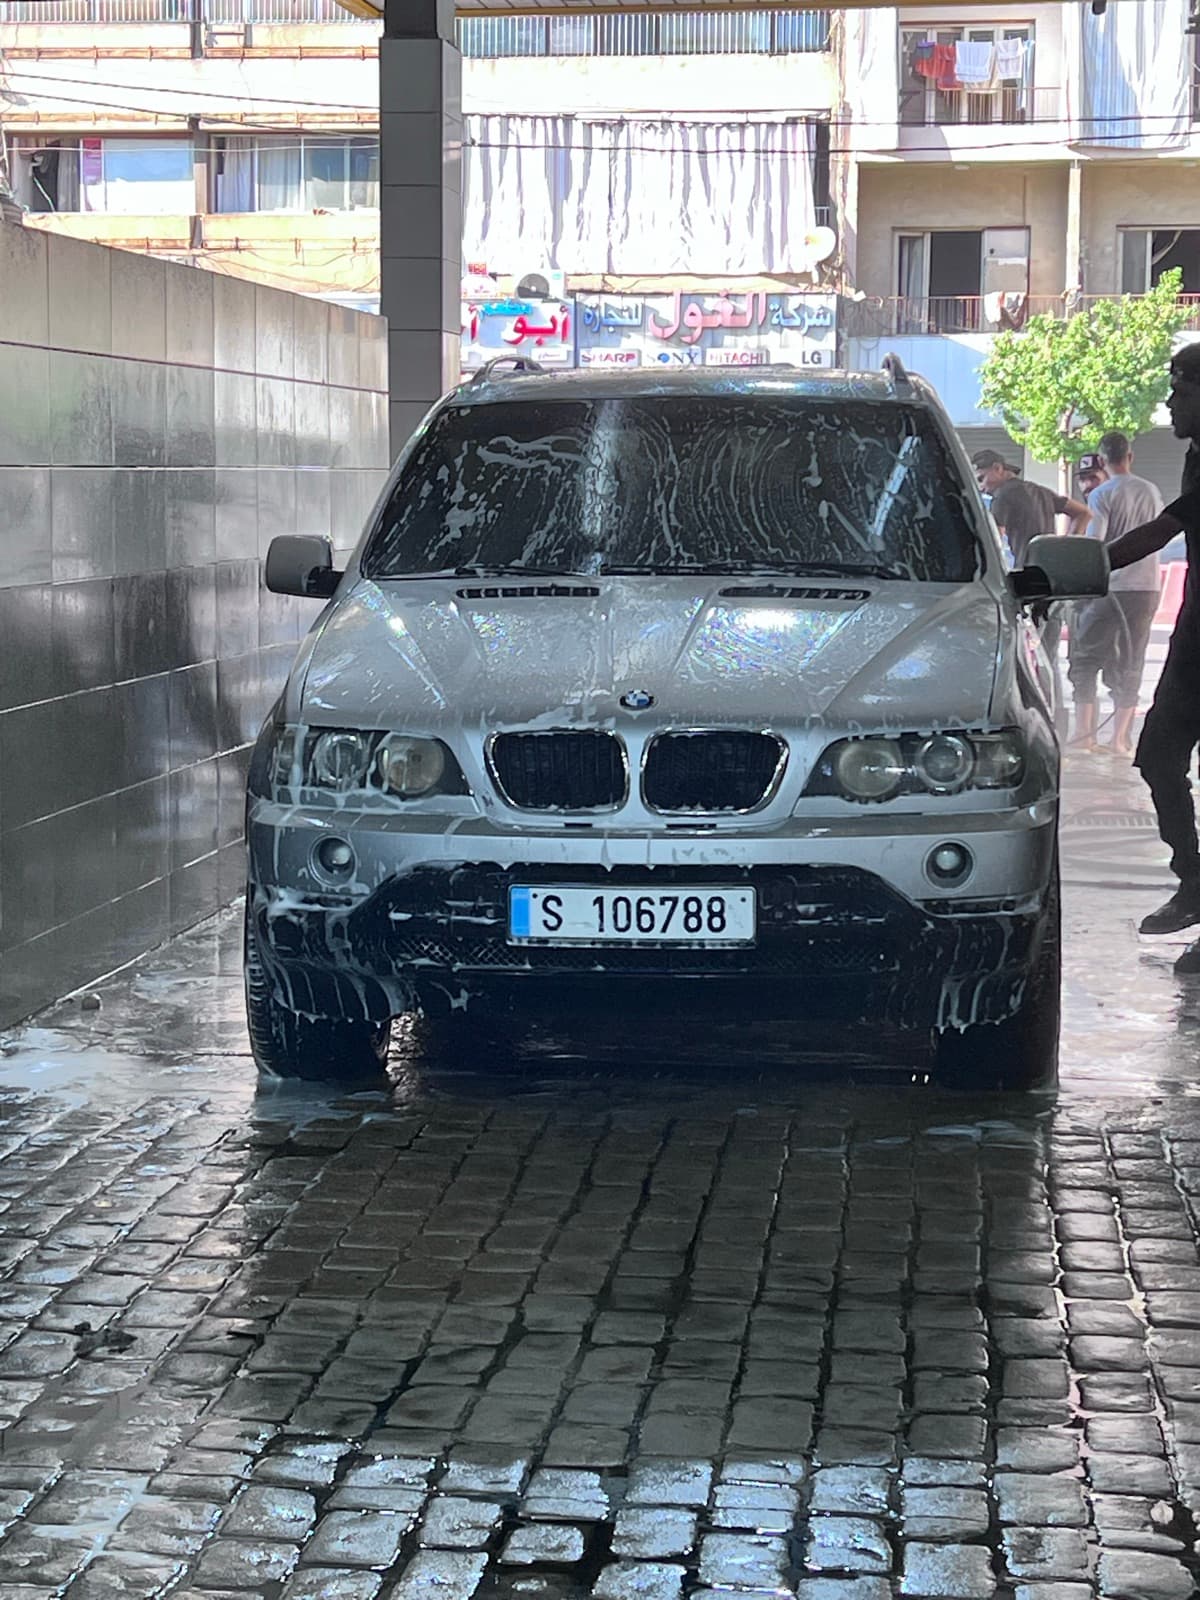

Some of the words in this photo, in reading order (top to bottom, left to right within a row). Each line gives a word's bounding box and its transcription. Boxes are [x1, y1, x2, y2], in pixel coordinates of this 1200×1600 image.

[503, 305, 571, 346] أبو
[583, 300, 643, 334] للتجارة
[768, 302, 831, 337] شركة
[581, 352, 637, 364] SHARP
[651, 351, 699, 365] SONY
[709, 352, 764, 365] HITACHI
[801, 350, 822, 365] LG
[541, 894, 563, 932] S
[592, 895, 727, 934] 106788
